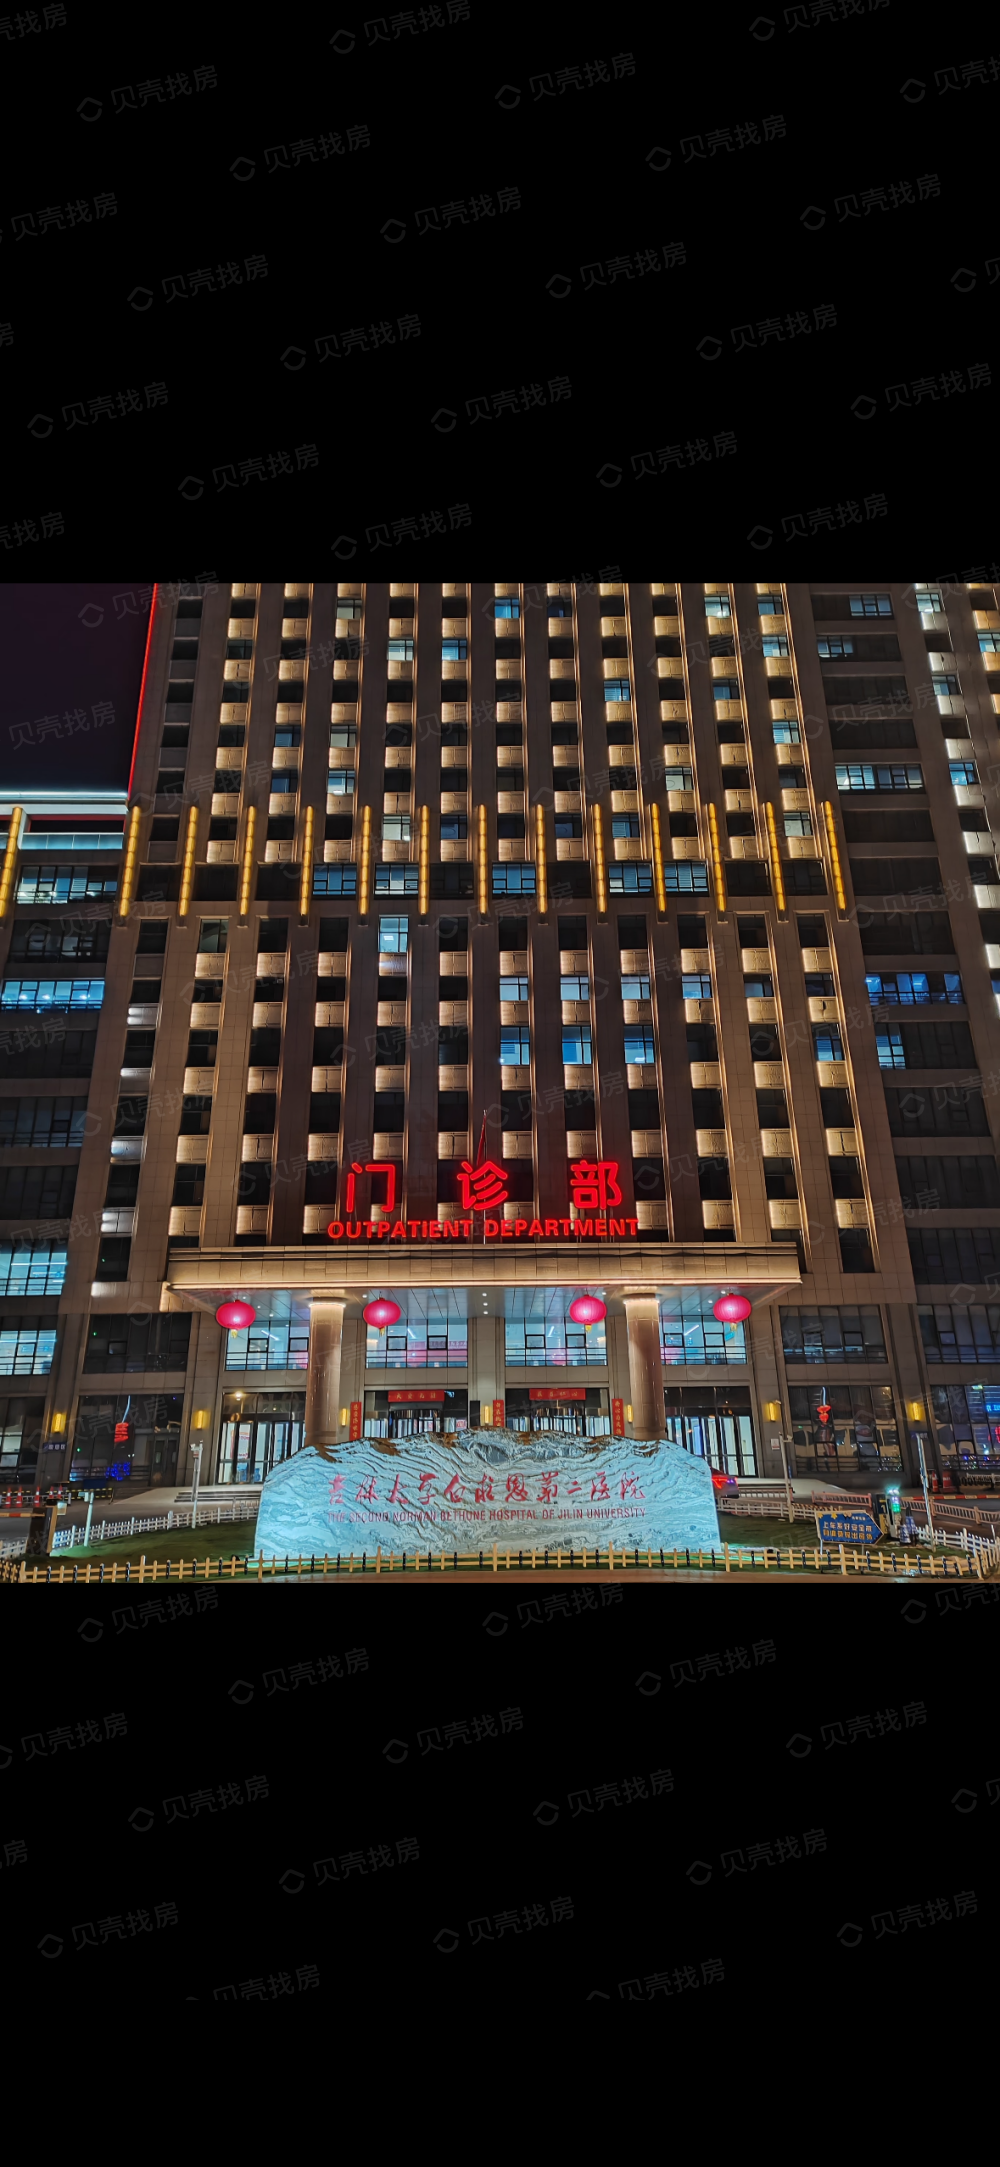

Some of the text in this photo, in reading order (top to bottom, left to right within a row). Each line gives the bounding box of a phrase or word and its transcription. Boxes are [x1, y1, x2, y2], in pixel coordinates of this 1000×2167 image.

[346, 1160, 622, 1212] 门诊部
[327, 1217, 639, 1239] OUTPATIENT DEPARTMENT
[328, 1507, 646, 1523] THE SECOND NORMAN BETHUNE HOSPITAL OF JILIN UNIVERSITY
